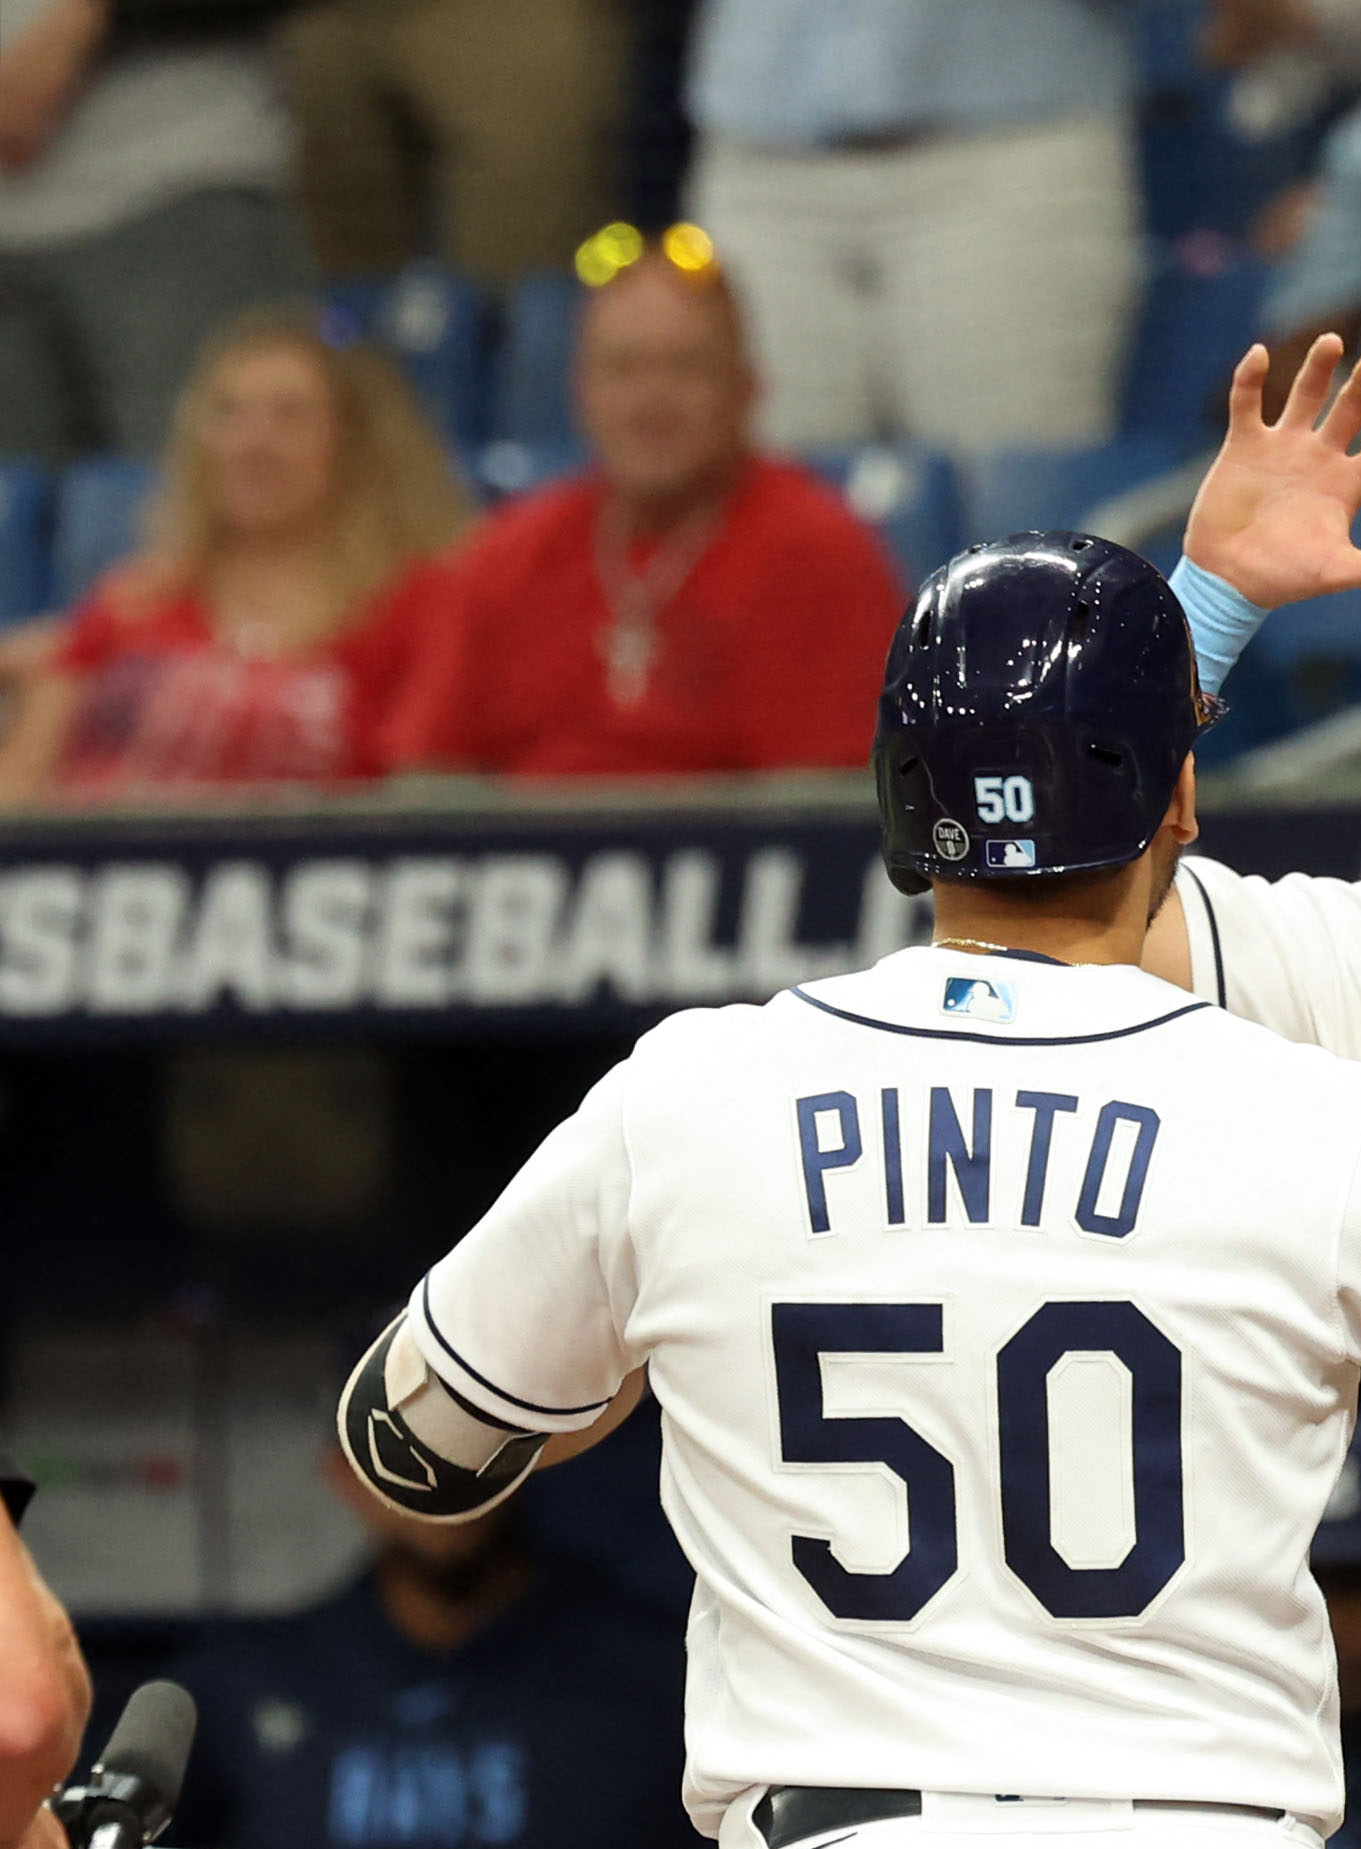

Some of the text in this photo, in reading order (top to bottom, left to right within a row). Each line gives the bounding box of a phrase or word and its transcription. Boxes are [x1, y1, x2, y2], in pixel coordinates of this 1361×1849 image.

[937, 826, 961, 841] DAVE
[974, 775, 1033, 824] 50
[796, 1086, 1161, 1239] PINTO
[771, 1300, 1186, 1621] 50
